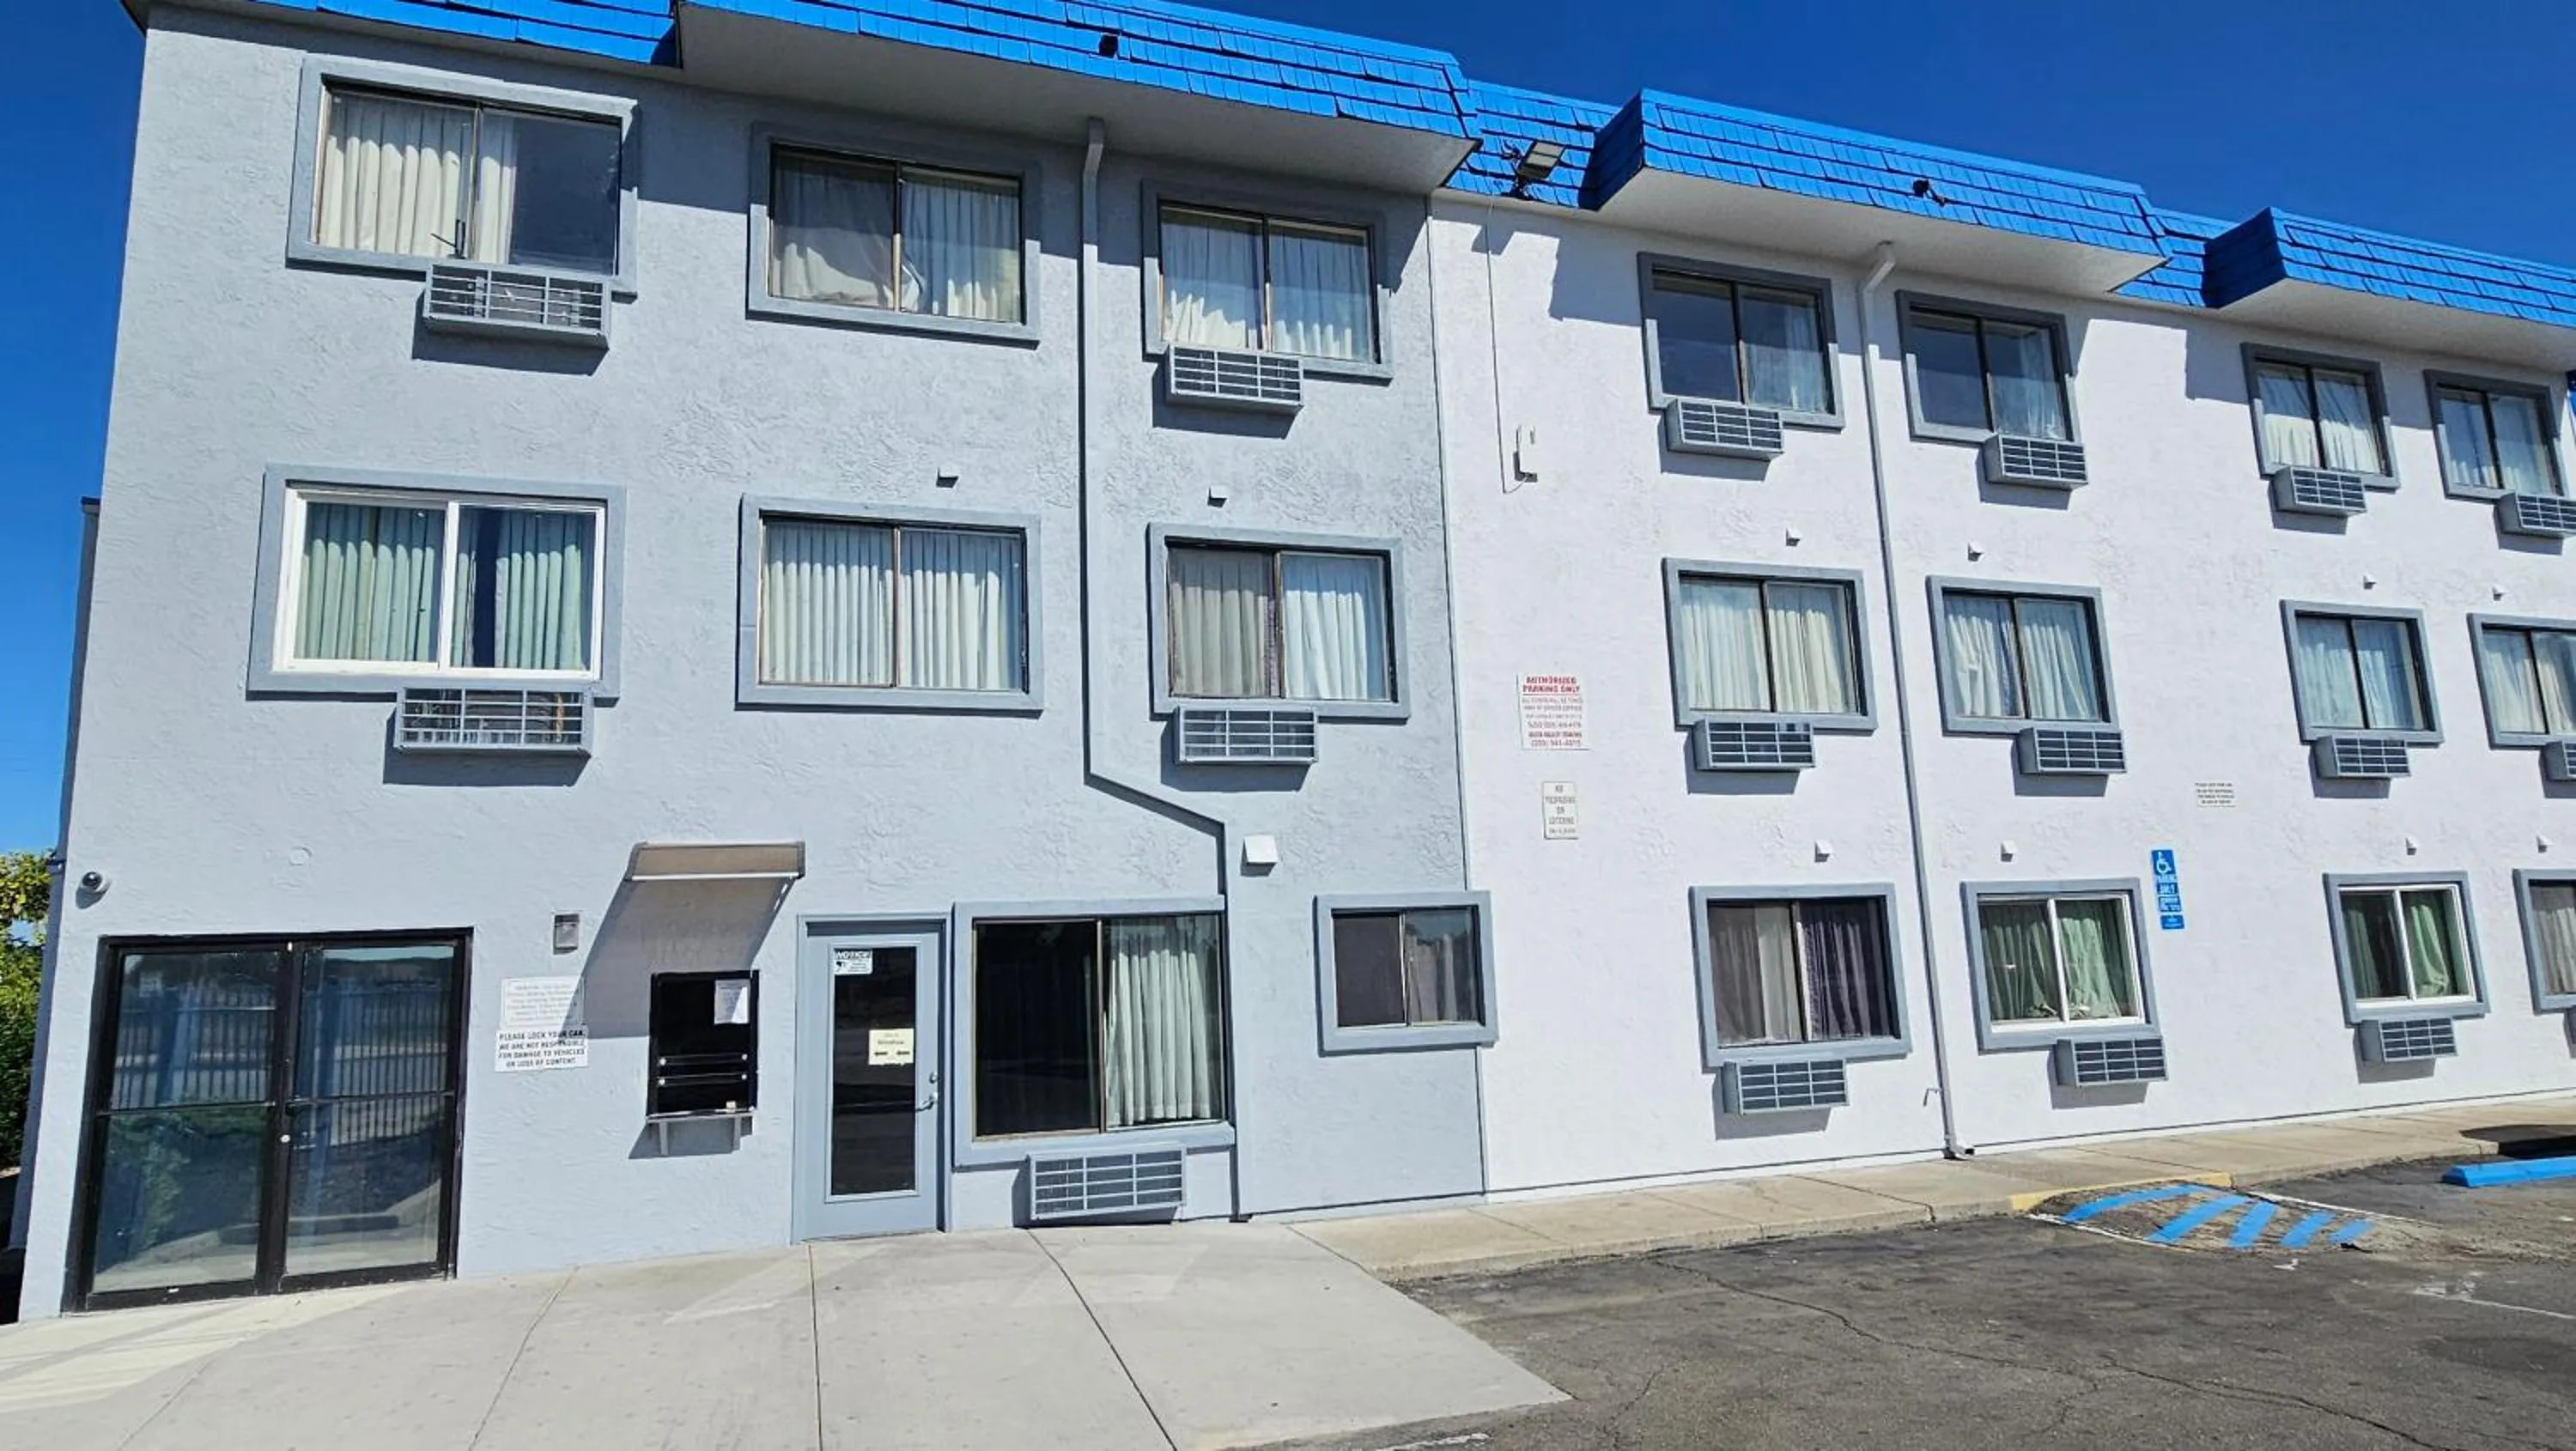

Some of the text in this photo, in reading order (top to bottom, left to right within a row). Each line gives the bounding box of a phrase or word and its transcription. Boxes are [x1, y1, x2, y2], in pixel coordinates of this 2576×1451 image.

[1522, 684, 1581, 693] PARKING ONLY
[499, 1033, 526, 1041] PLEASE
[554, 1047, 585, 1056] VEHICLES
